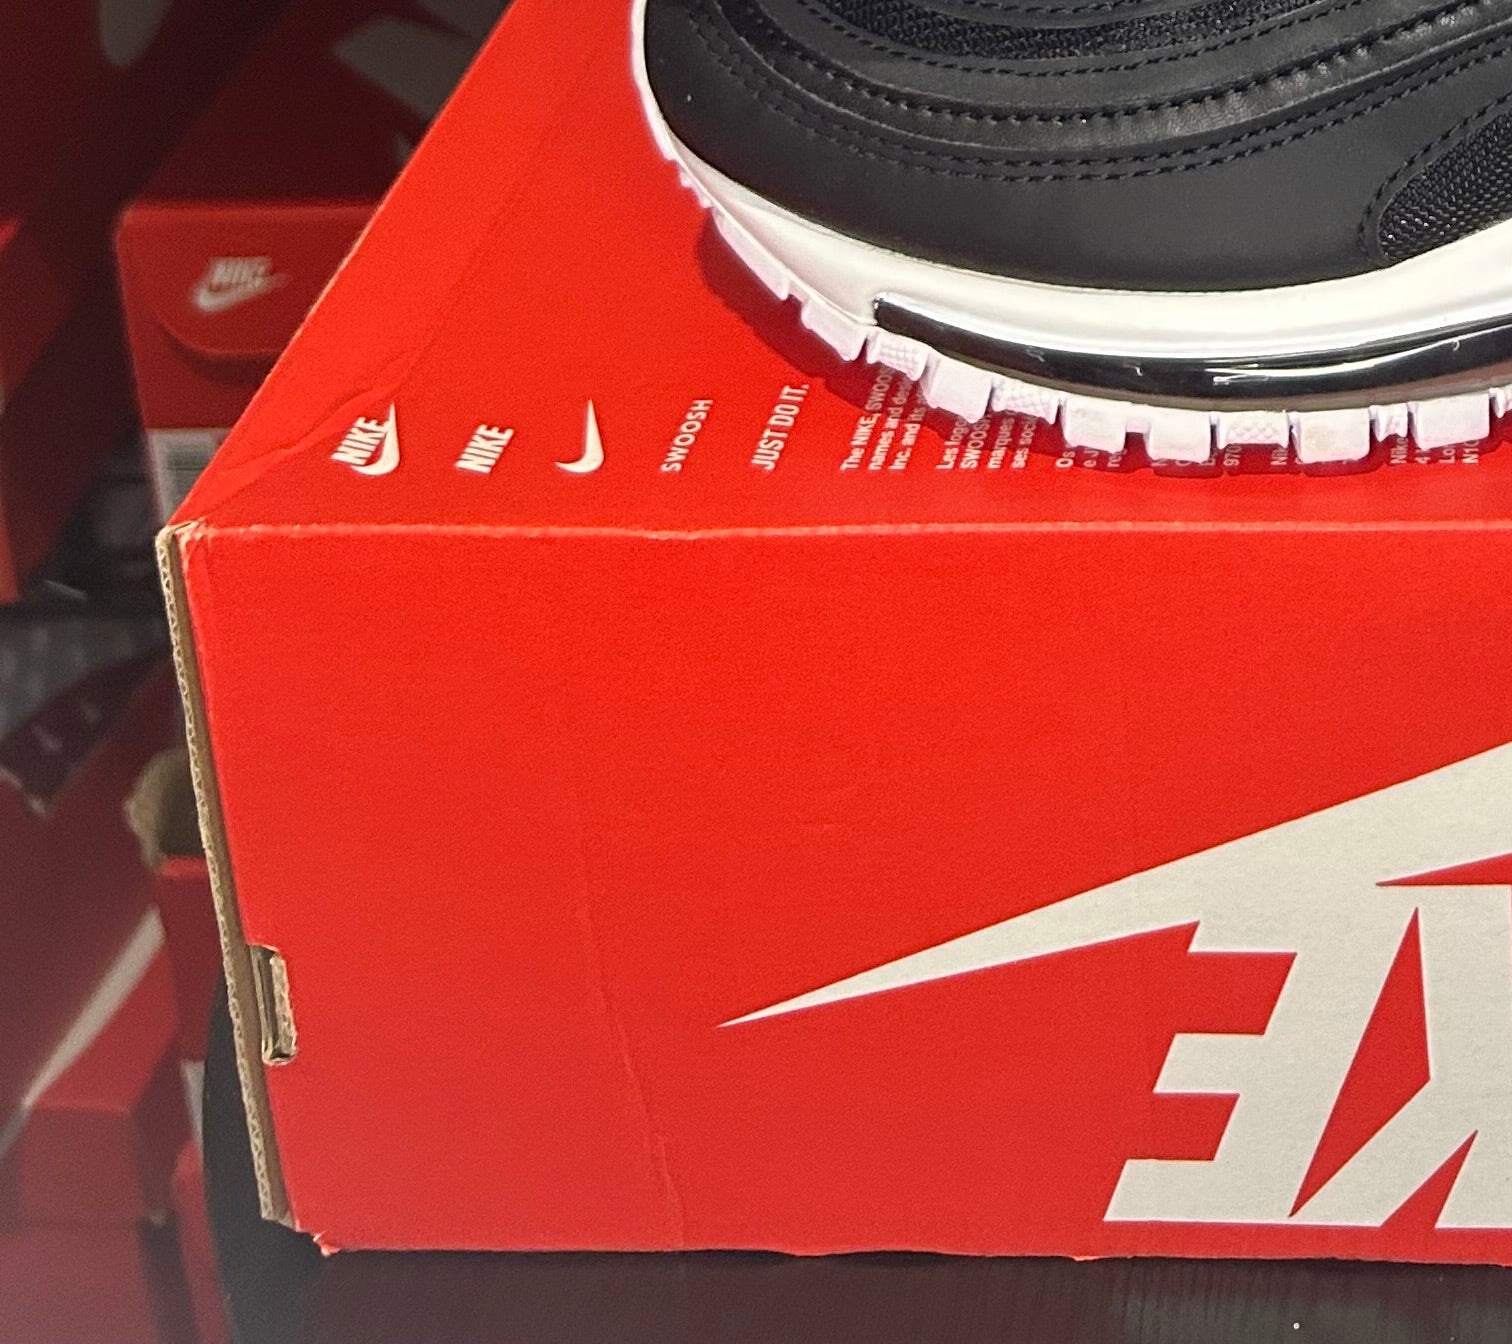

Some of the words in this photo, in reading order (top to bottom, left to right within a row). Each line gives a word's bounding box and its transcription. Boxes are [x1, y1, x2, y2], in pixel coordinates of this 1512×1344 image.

[780, 385, 809, 401] IT.
[865, 366, 897, 410] SWOOS
[768, 404, 799, 426] DO
[850, 413, 881, 446] NIKE,
[1019, 416, 1041, 445] soci
[331, 415, 390, 466] NIKE
[456, 423, 515, 474] NIKE
[660, 398, 714, 473] SWOOSH
[751, 428, 788, 470] JUST
[868, 431, 894, 470] names
[885, 408, 902, 429] and
[888, 448, 912, 470] Inc.
[901, 423, 920, 446] and
[987, 418, 1014, 469] marques
[840, 448, 865, 470] The
[936, 448, 958, 469] Les
[1012, 448, 1028, 468] ses
[1055, 451, 1075, 468] Os
